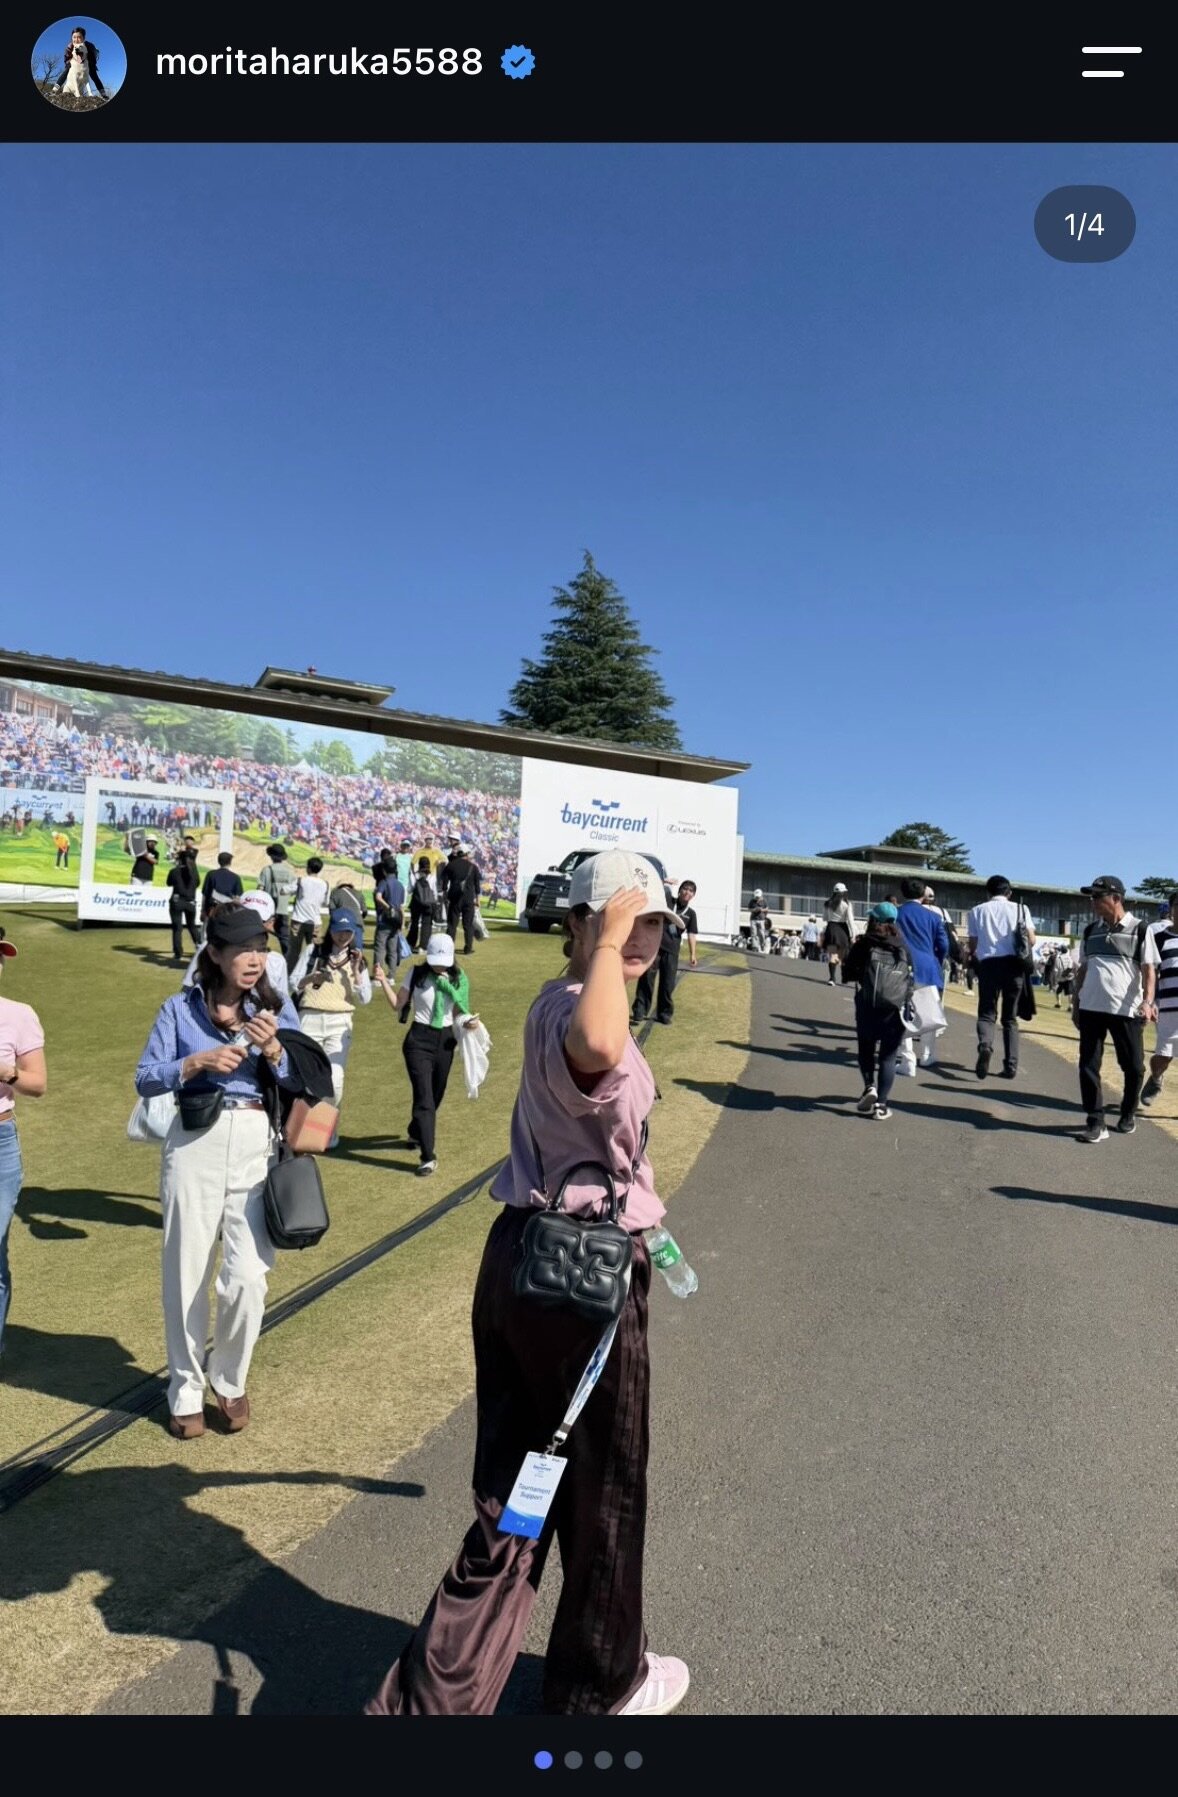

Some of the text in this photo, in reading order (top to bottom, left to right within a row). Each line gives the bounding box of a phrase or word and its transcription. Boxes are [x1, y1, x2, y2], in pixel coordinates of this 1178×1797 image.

[561, 803, 648, 833] baycurrent
[590, 831, 619, 842] Classic
[93, 893, 167, 908] baycurrent
[519, 1483, 551, 1496] Tournament
[520, 1491, 543, 1501] Support
